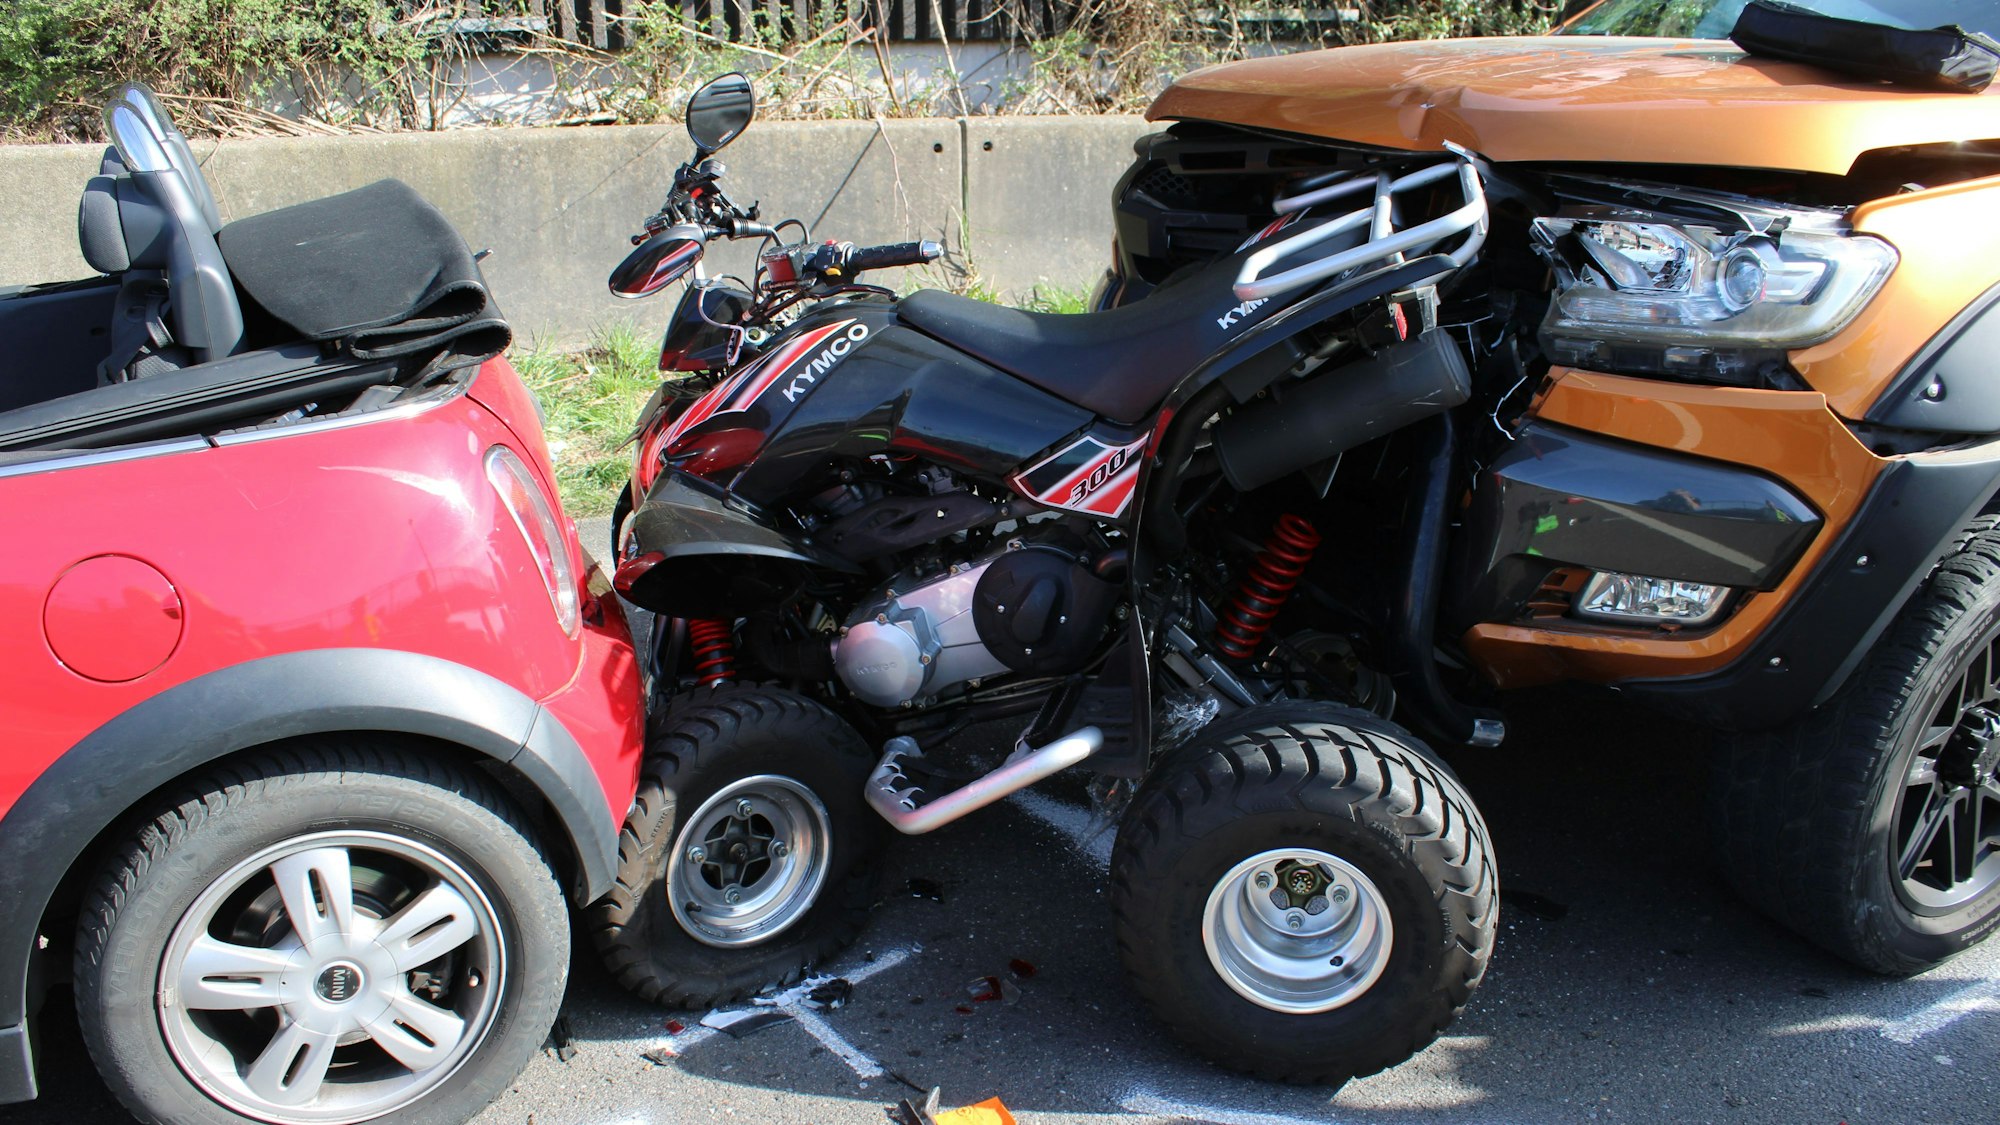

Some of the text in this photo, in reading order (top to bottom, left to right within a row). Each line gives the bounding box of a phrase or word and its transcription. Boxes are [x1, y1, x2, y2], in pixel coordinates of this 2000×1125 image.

[1216, 297, 1270, 331] KYM
[782, 323, 869, 403] KYMCO
[1069, 447, 1128, 508] 300
[108, 852, 196, 1008] VREDESTEIN
[331, 968, 346, 998] MINI
